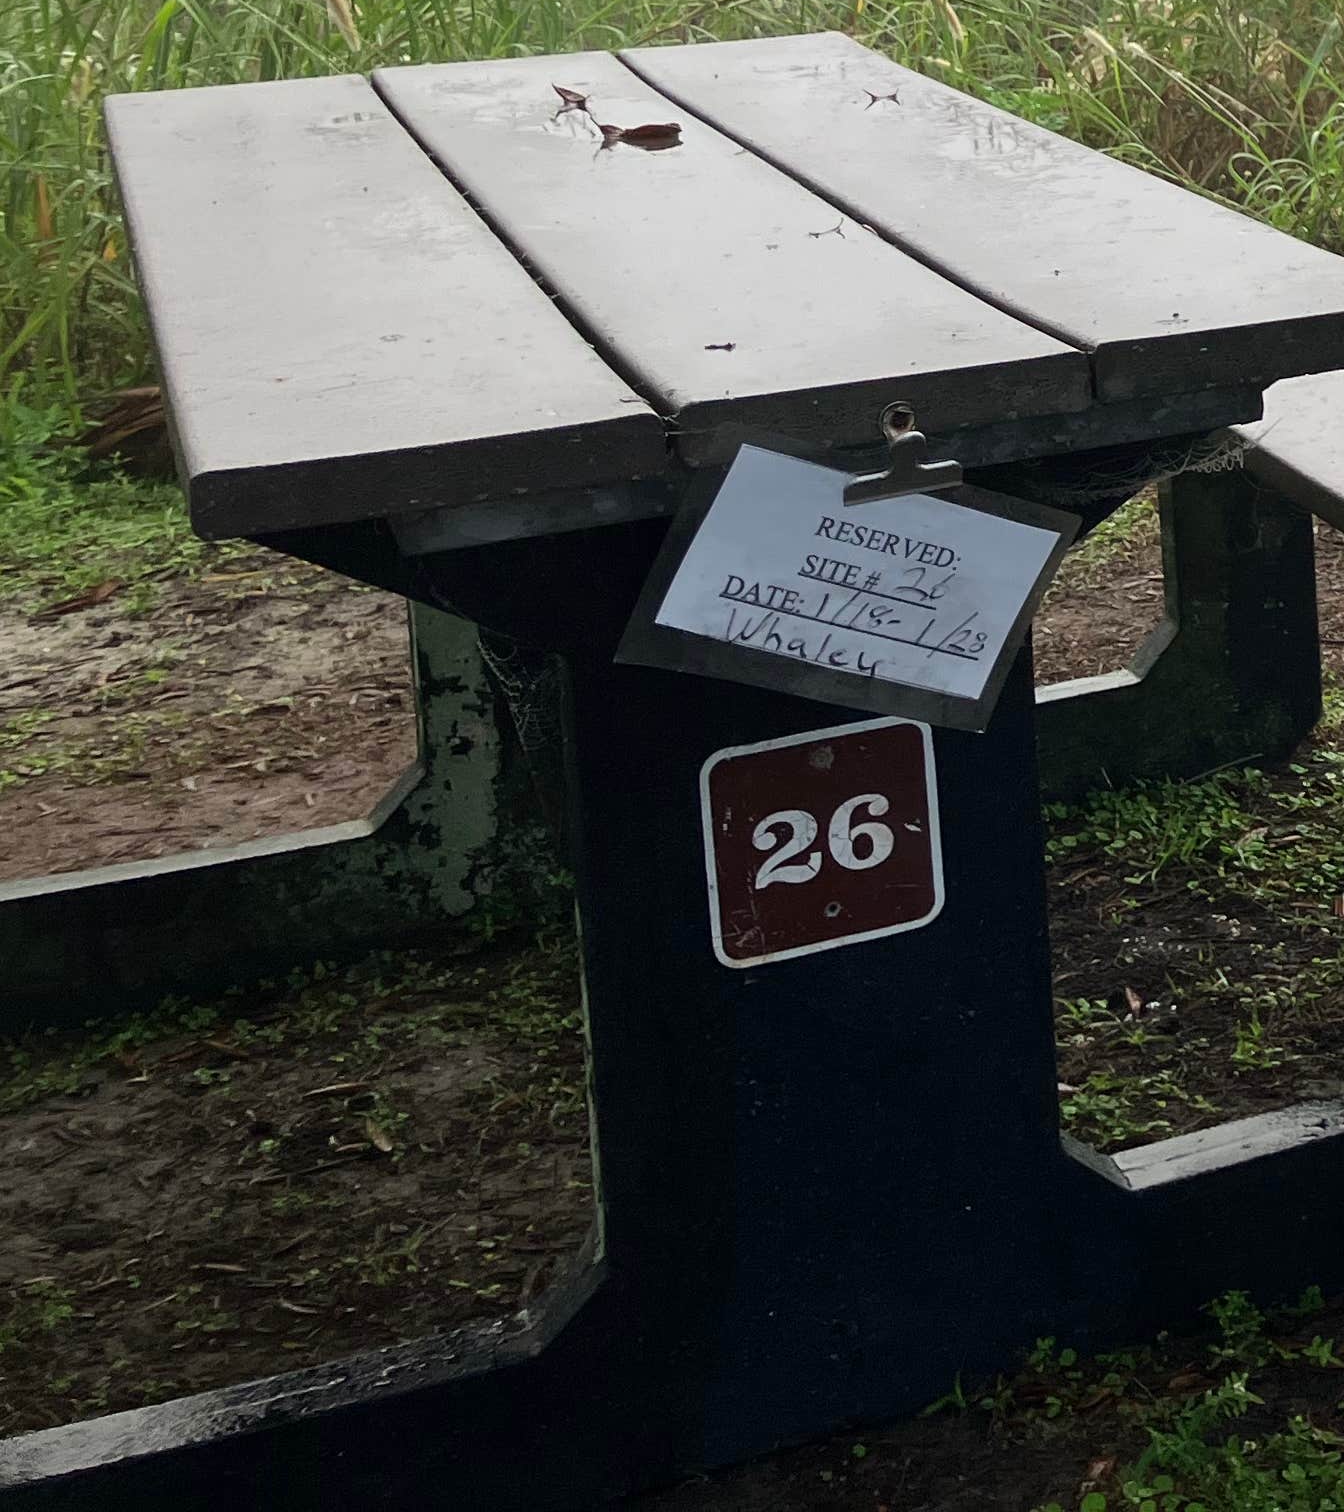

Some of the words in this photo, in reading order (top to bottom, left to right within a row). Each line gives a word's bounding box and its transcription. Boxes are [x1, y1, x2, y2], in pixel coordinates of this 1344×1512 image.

[815, 516, 962, 571] RESERVED:
[719, 574, 805, 615] DATE:
[799, 554, 863, 586] SITE
[864, 572, 881, 592] #
[893, 567, 957, 601] 26
[725, 608, 879, 677] Whaley
[752, 793, 894, 890] 26
